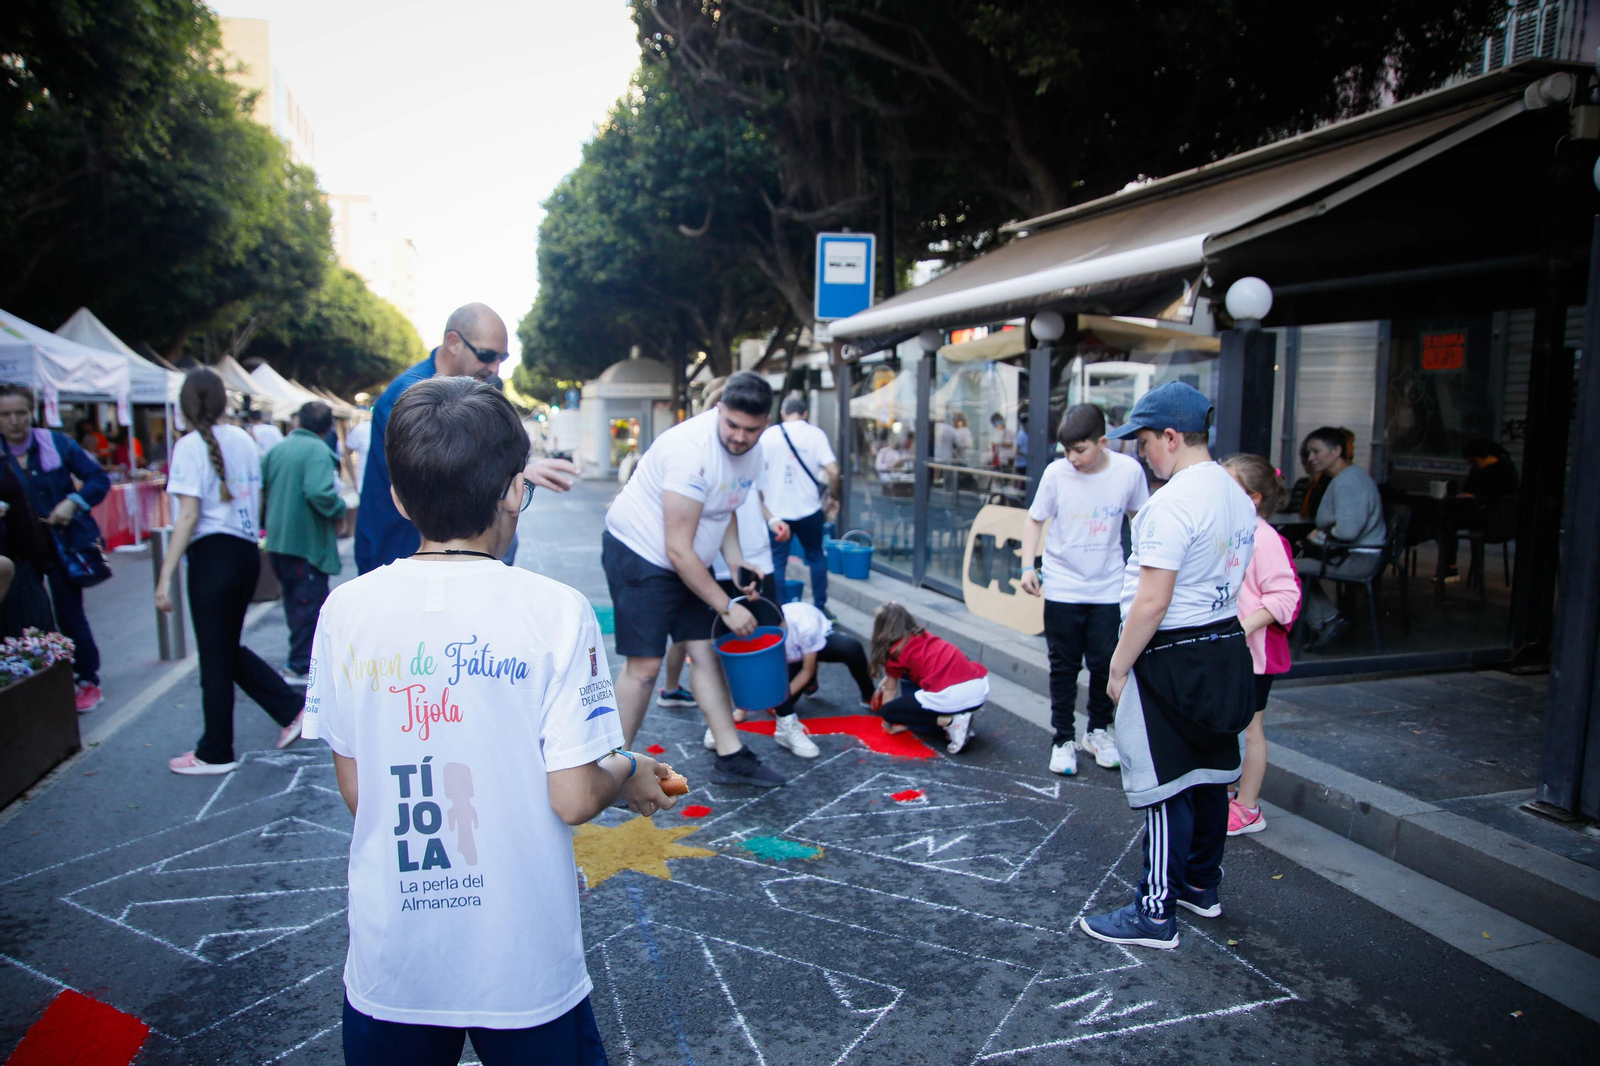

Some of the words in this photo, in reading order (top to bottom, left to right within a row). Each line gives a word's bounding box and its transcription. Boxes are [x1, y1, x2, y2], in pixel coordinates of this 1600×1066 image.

[342, 642, 404, 692] Virgen
[410, 641, 438, 676] de
[444, 634, 531, 686] Fátima
[388, 683, 464, 741] Tíjola
[390, 755, 434, 799] TÍ
[393, 801, 443, 836] JO
[397, 838, 452, 873] LA
[400, 880, 419, 894] La
[422, 876, 459, 894] perla
[462, 874, 484, 888] del
[401, 895, 482, 912] Almanzora
